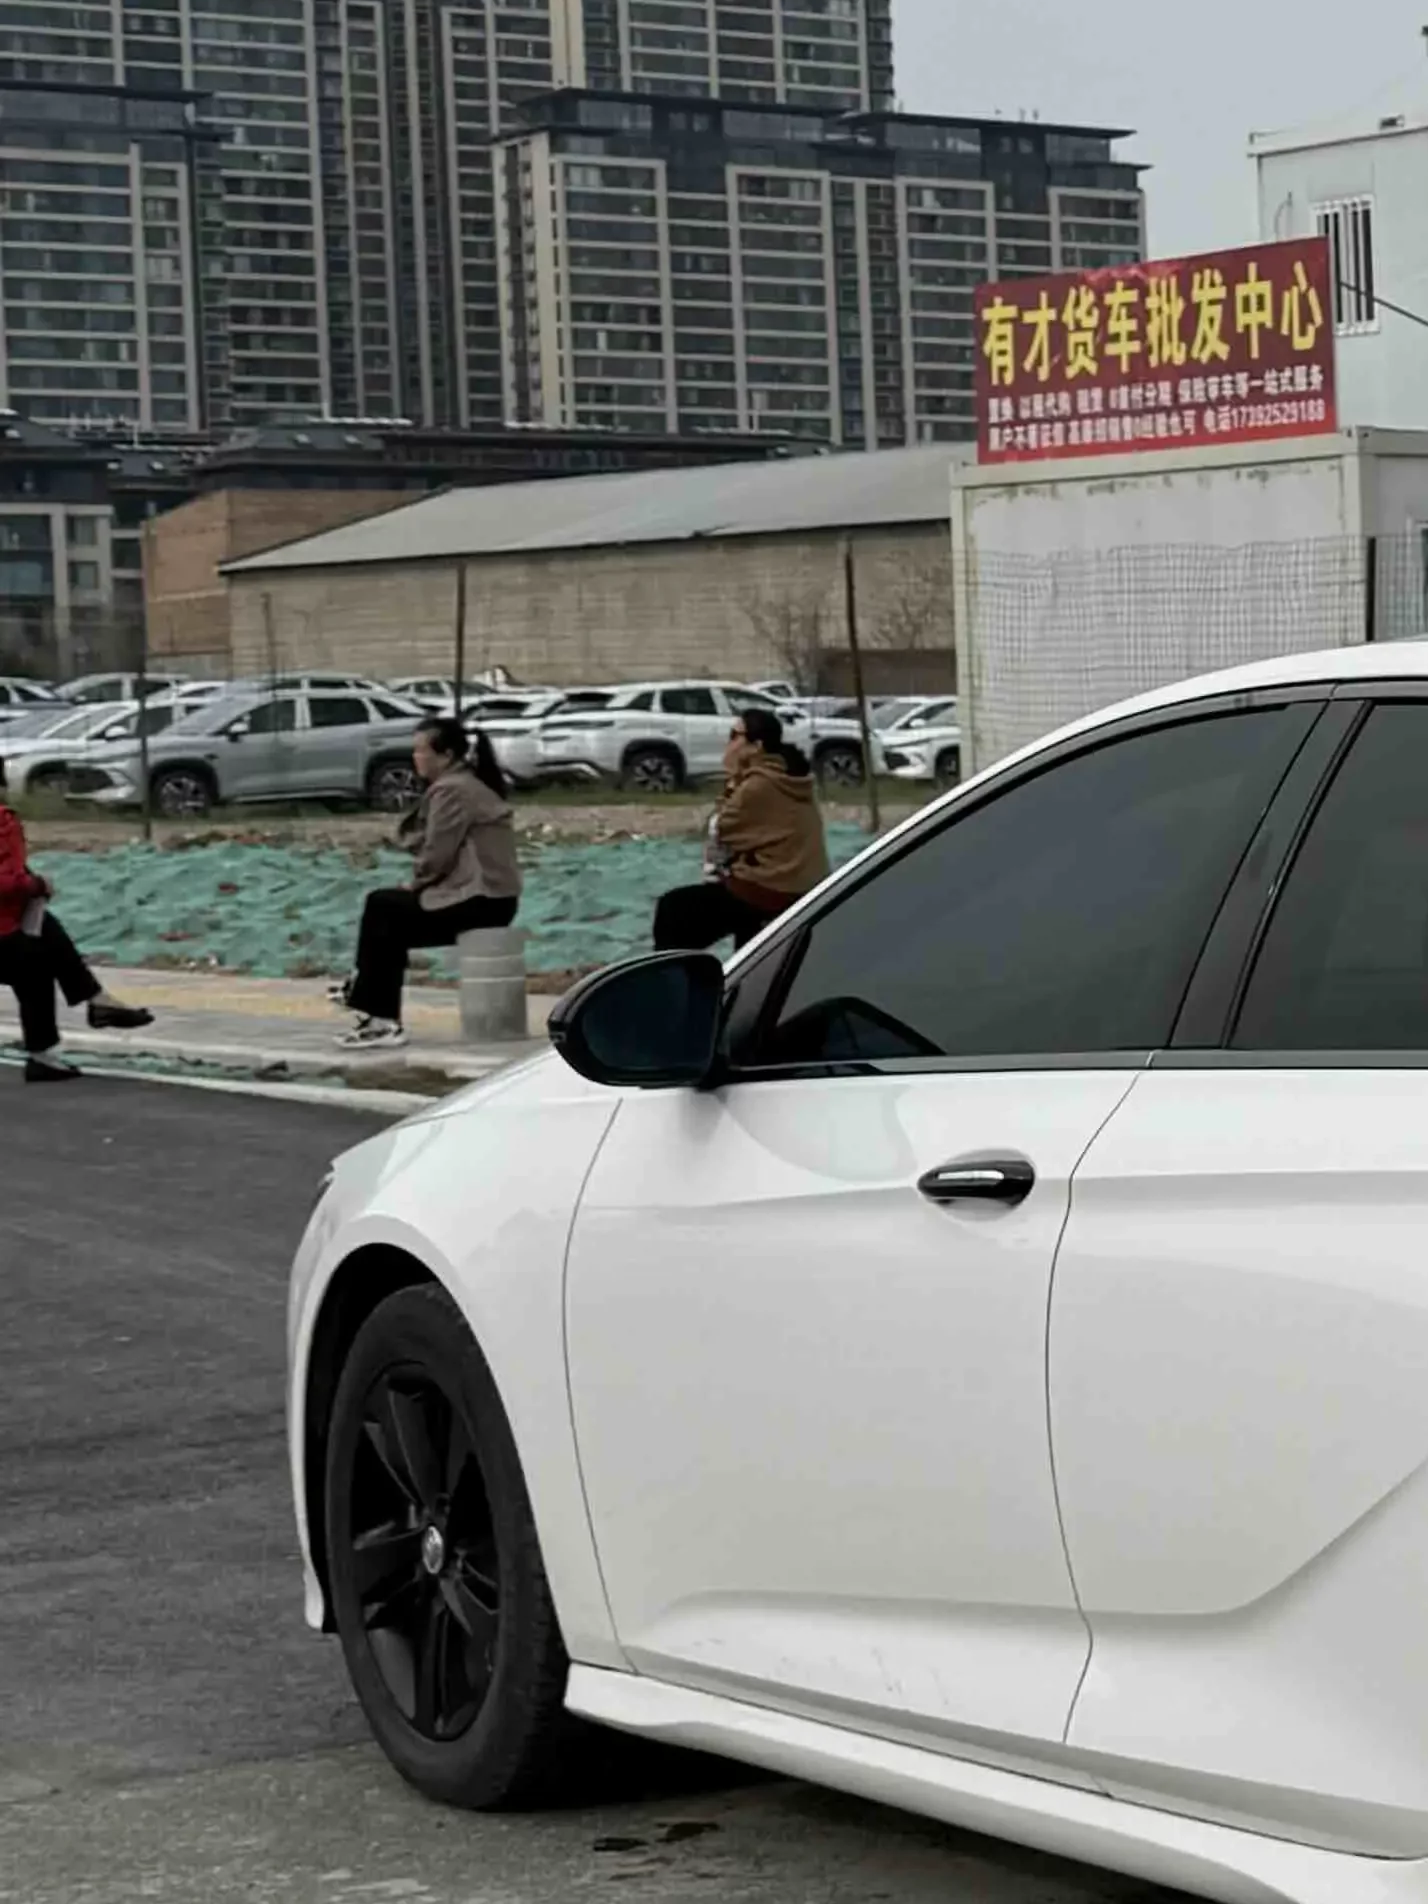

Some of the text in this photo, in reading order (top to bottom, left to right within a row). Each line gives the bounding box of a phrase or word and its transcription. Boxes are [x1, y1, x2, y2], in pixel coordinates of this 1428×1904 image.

[982, 261, 1322, 386] 有才货车批发中心
